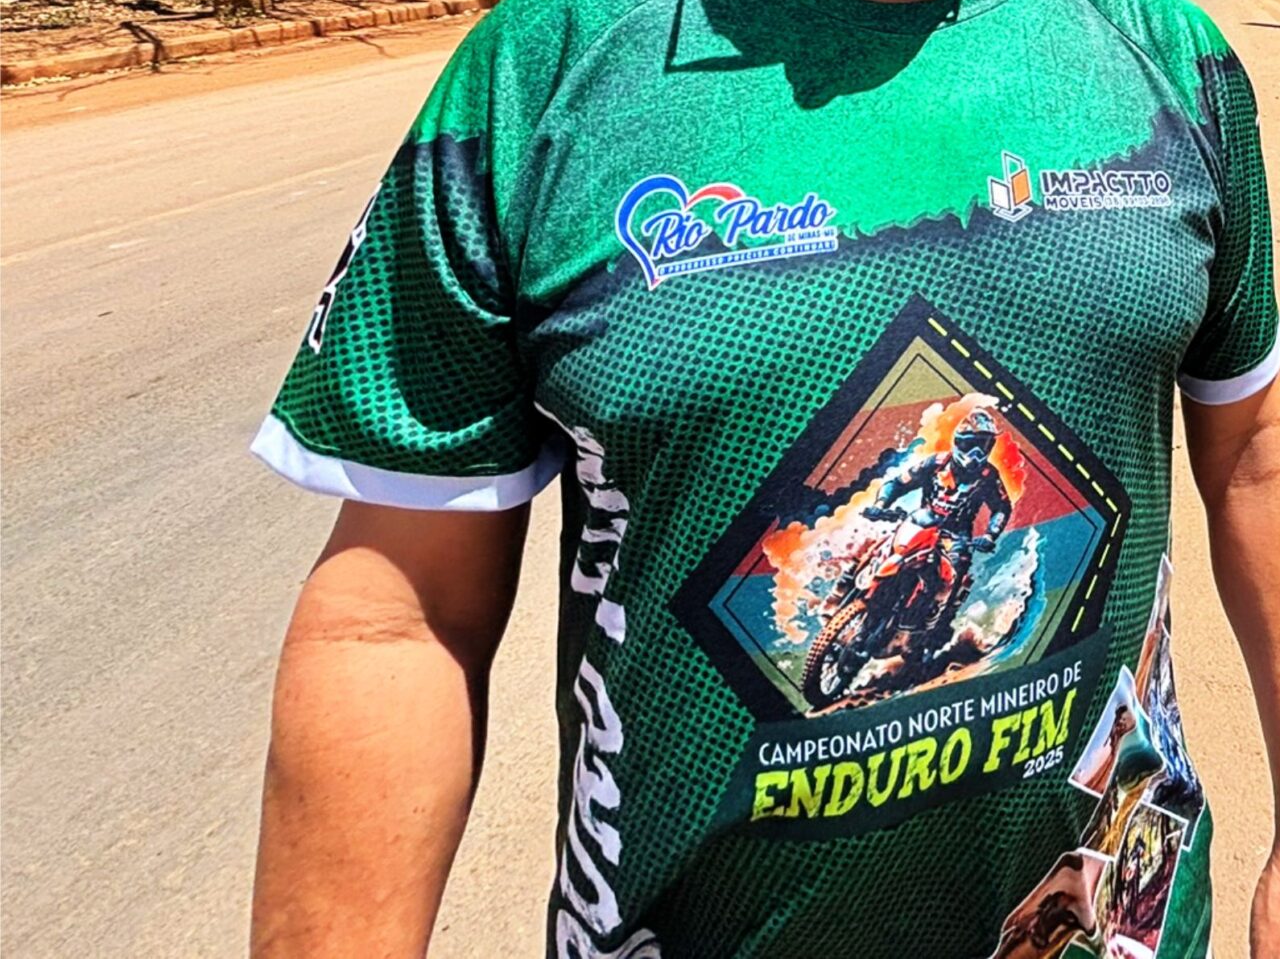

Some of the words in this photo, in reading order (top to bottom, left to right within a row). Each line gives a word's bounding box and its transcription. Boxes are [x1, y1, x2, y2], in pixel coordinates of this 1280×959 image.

[1041, 171, 1170, 194] IMPACTTO
[1046, 197, 1102, 209] MOVEIS
[644, 210, 711, 258] Rio
[716, 193, 833, 246] Pardo
[758, 719, 902, 767] CAMPEONATO
[908, 698, 975, 738] NORTE
[980, 673, 1059, 718] MINEIRO
[1063, 660, 1083, 689] DE
[751, 727, 972, 820] ENDURO
[982, 687, 1078, 774] FIM
[1023, 745, 1065, 779] 2025
